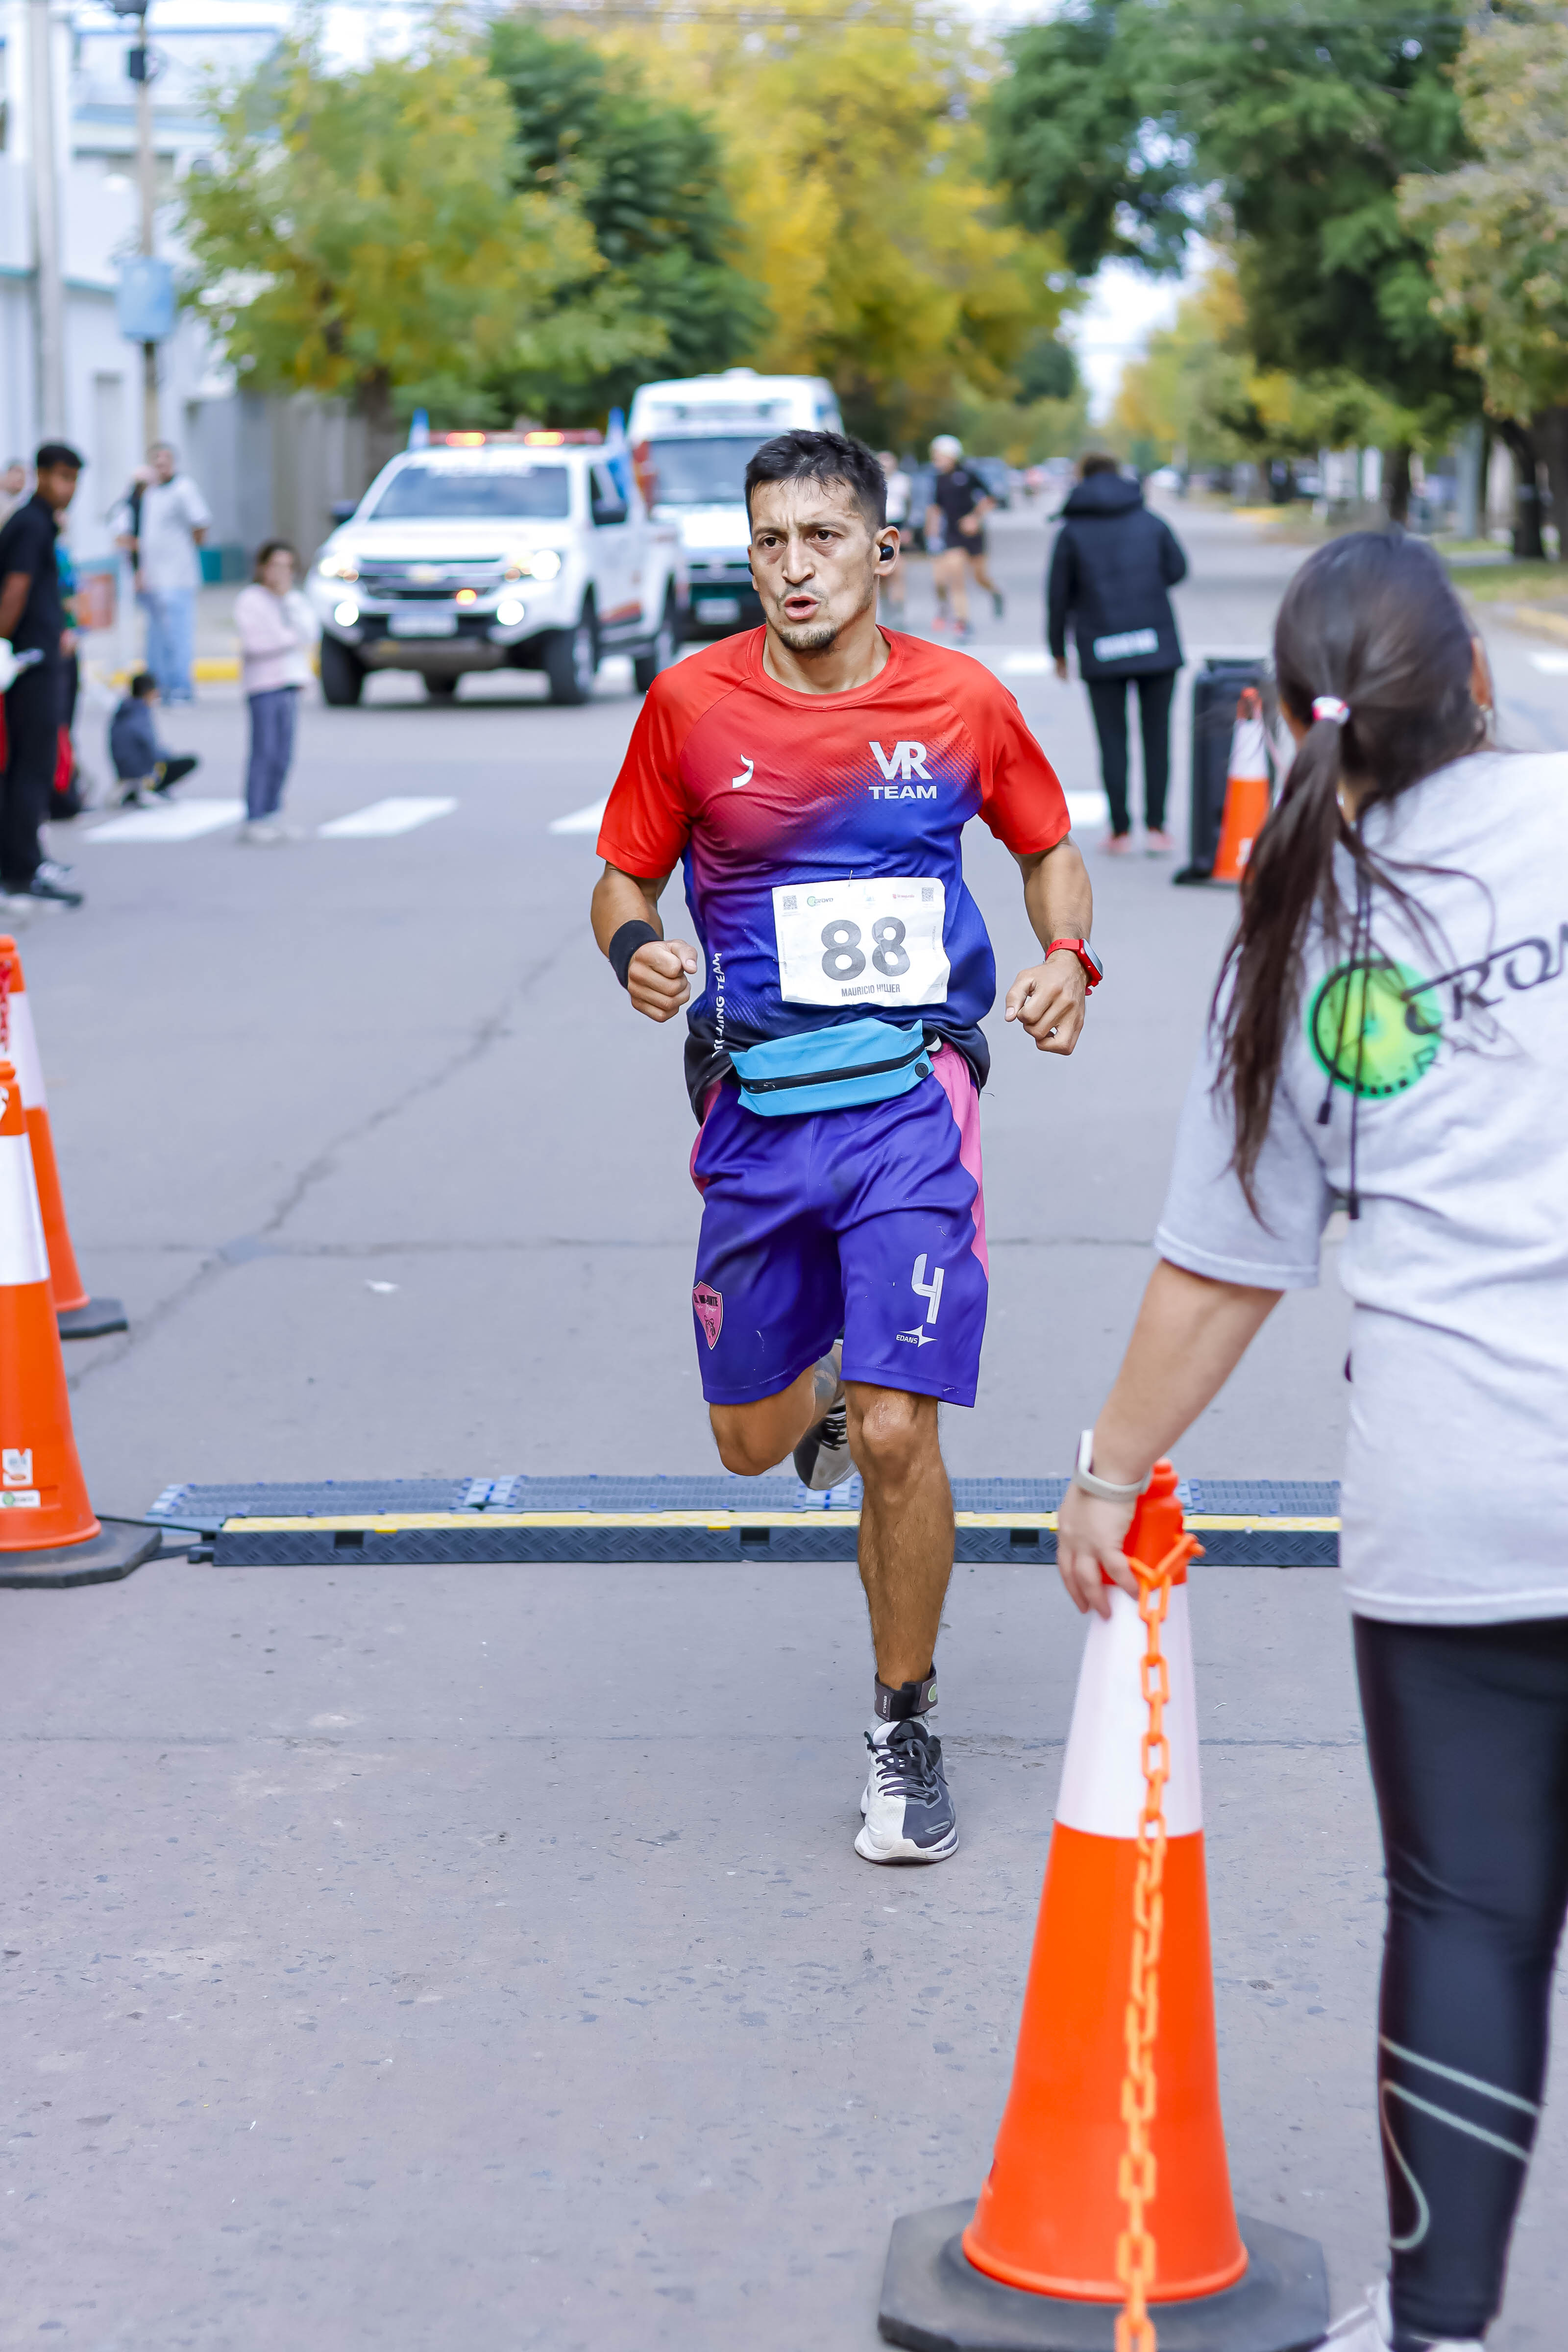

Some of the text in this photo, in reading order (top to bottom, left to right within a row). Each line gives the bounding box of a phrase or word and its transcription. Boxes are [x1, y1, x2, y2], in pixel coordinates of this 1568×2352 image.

[869, 740, 933, 780] VR
[868, 785, 937, 800] TEAM
[821, 916, 910, 981] 88
[712, 953, 725, 991] TEAM
[841, 984, 901, 997] MAURICIO HILLIER
[911, 1253, 945, 1324] 4
[896, 1334, 918, 1345] EDANS
